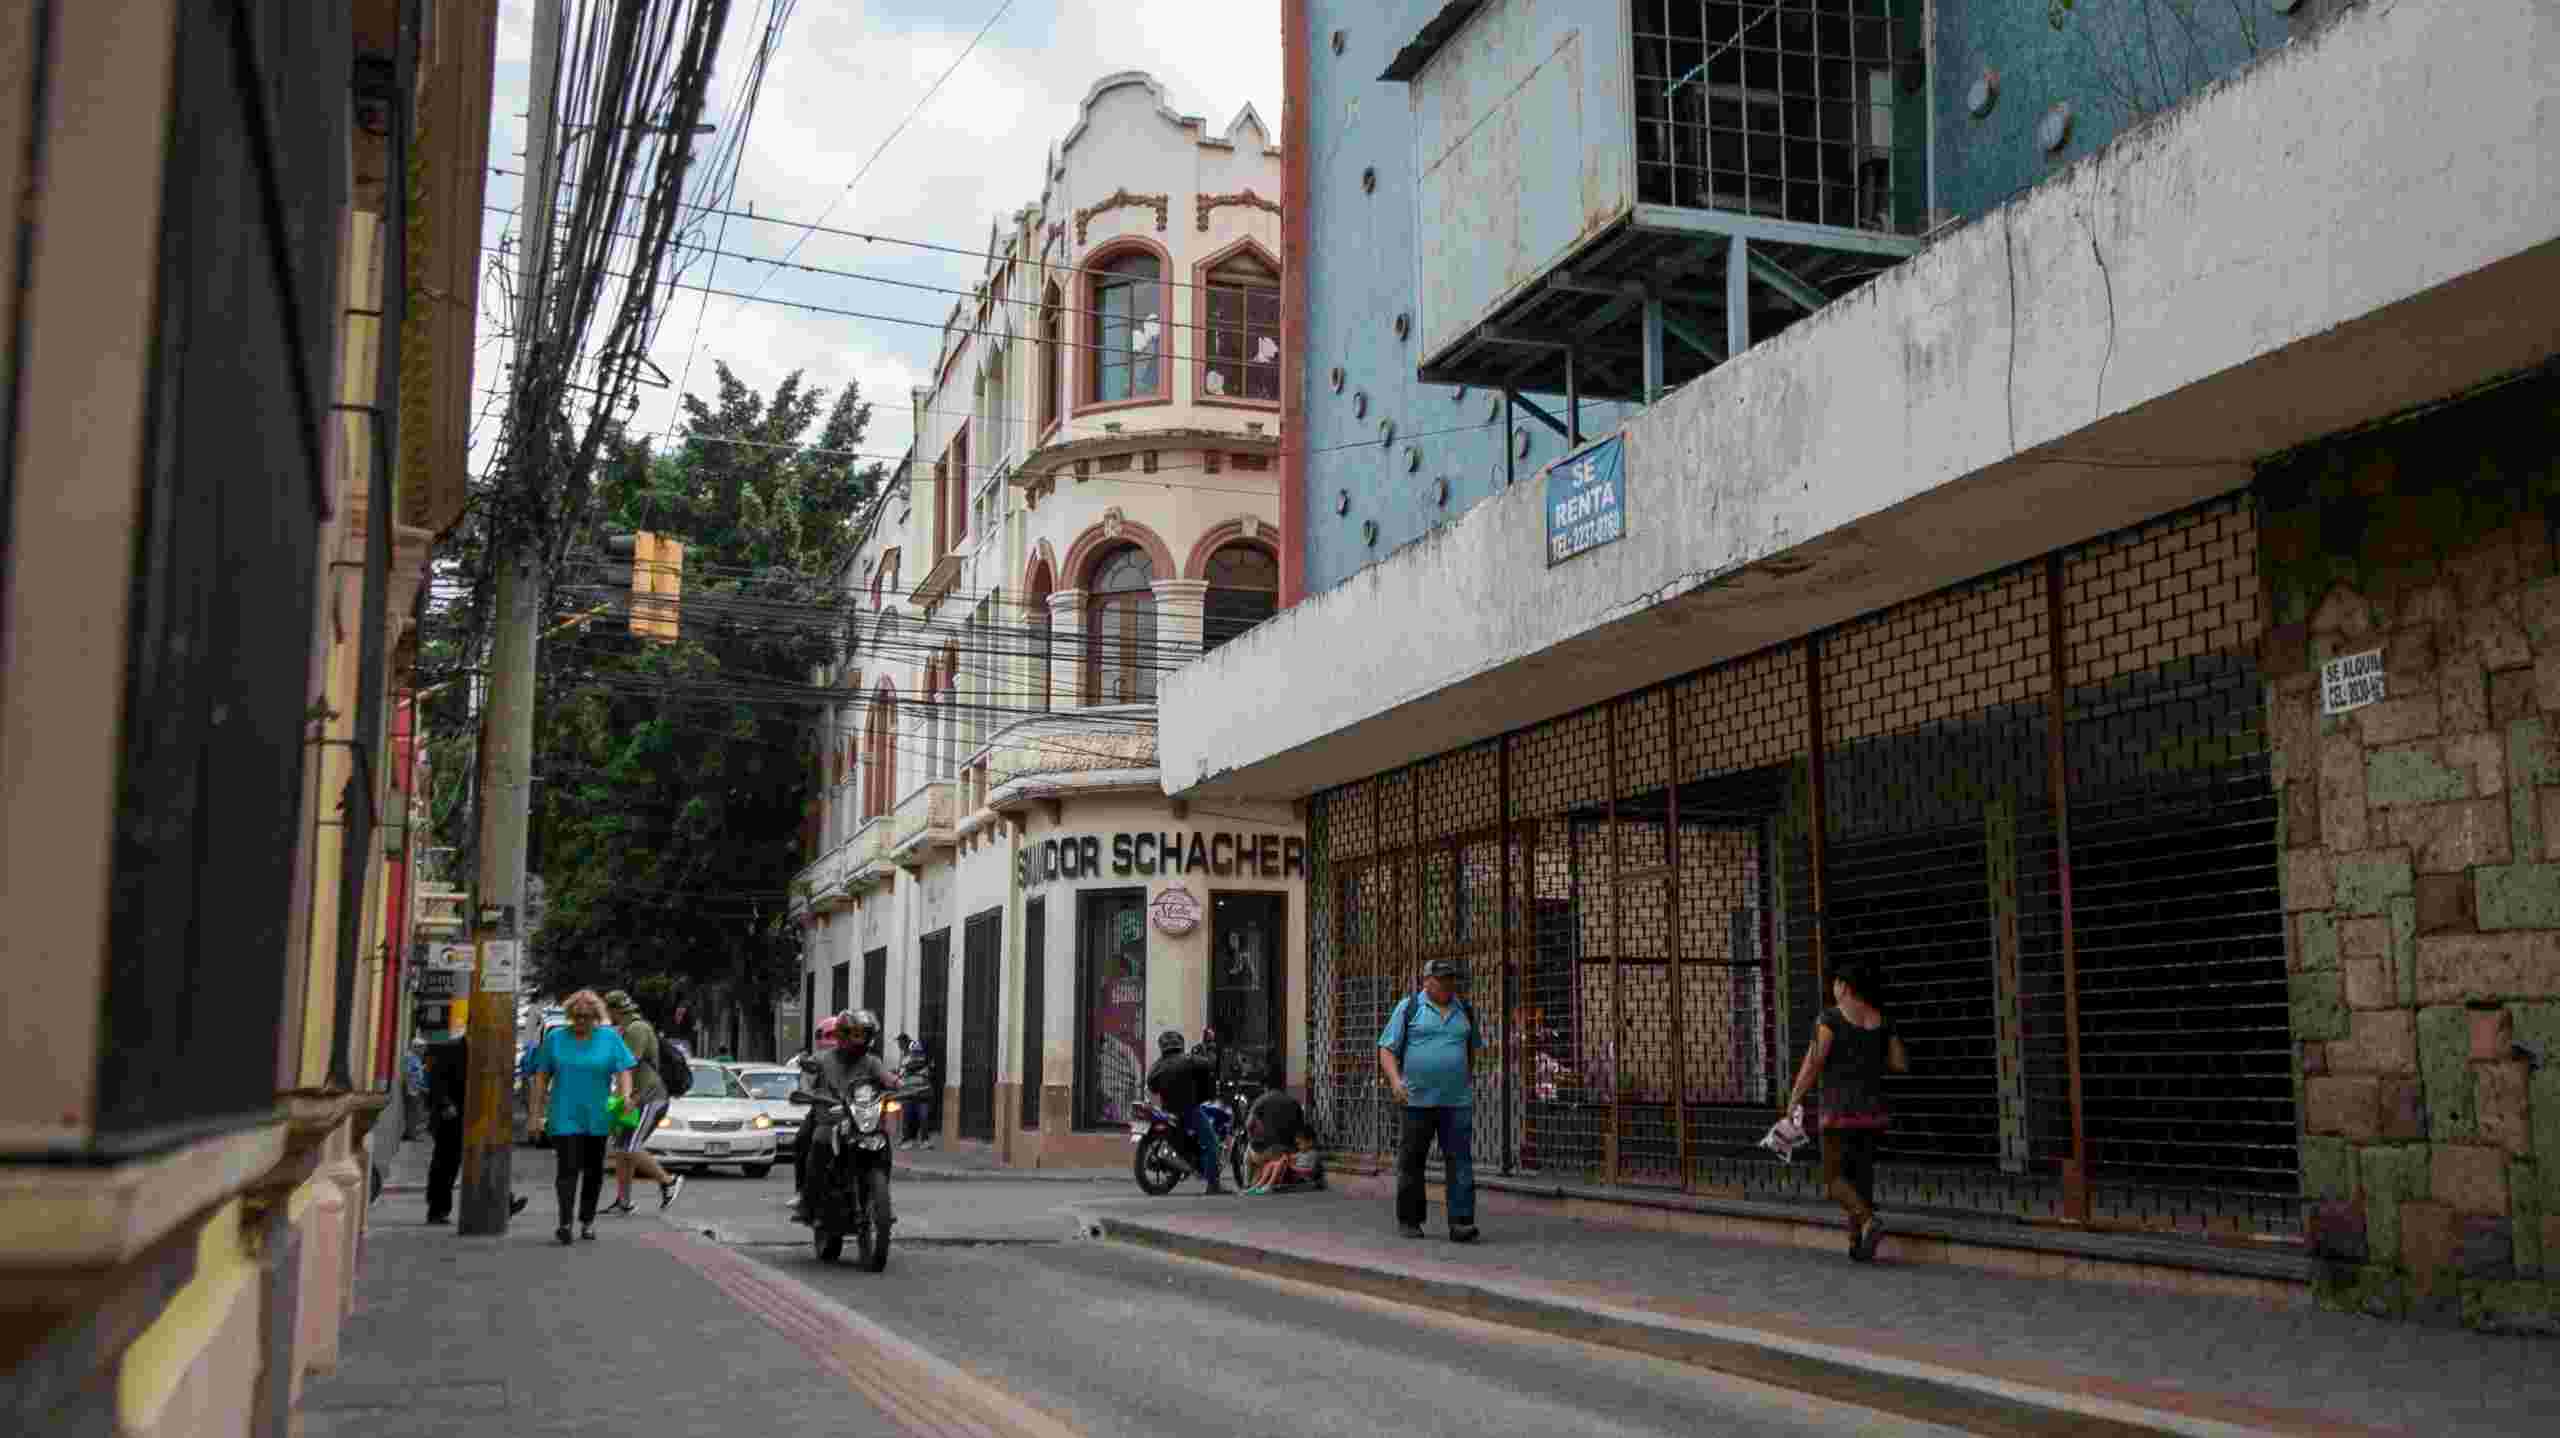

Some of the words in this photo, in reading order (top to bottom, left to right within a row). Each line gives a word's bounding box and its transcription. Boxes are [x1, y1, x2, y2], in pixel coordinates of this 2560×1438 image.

[1571, 458, 1596, 488] SE
[1556, 482, 1616, 527] RENTA
[2327, 663, 2341, 683] SE
[1112, 832, 1305, 878] SCHACHER
